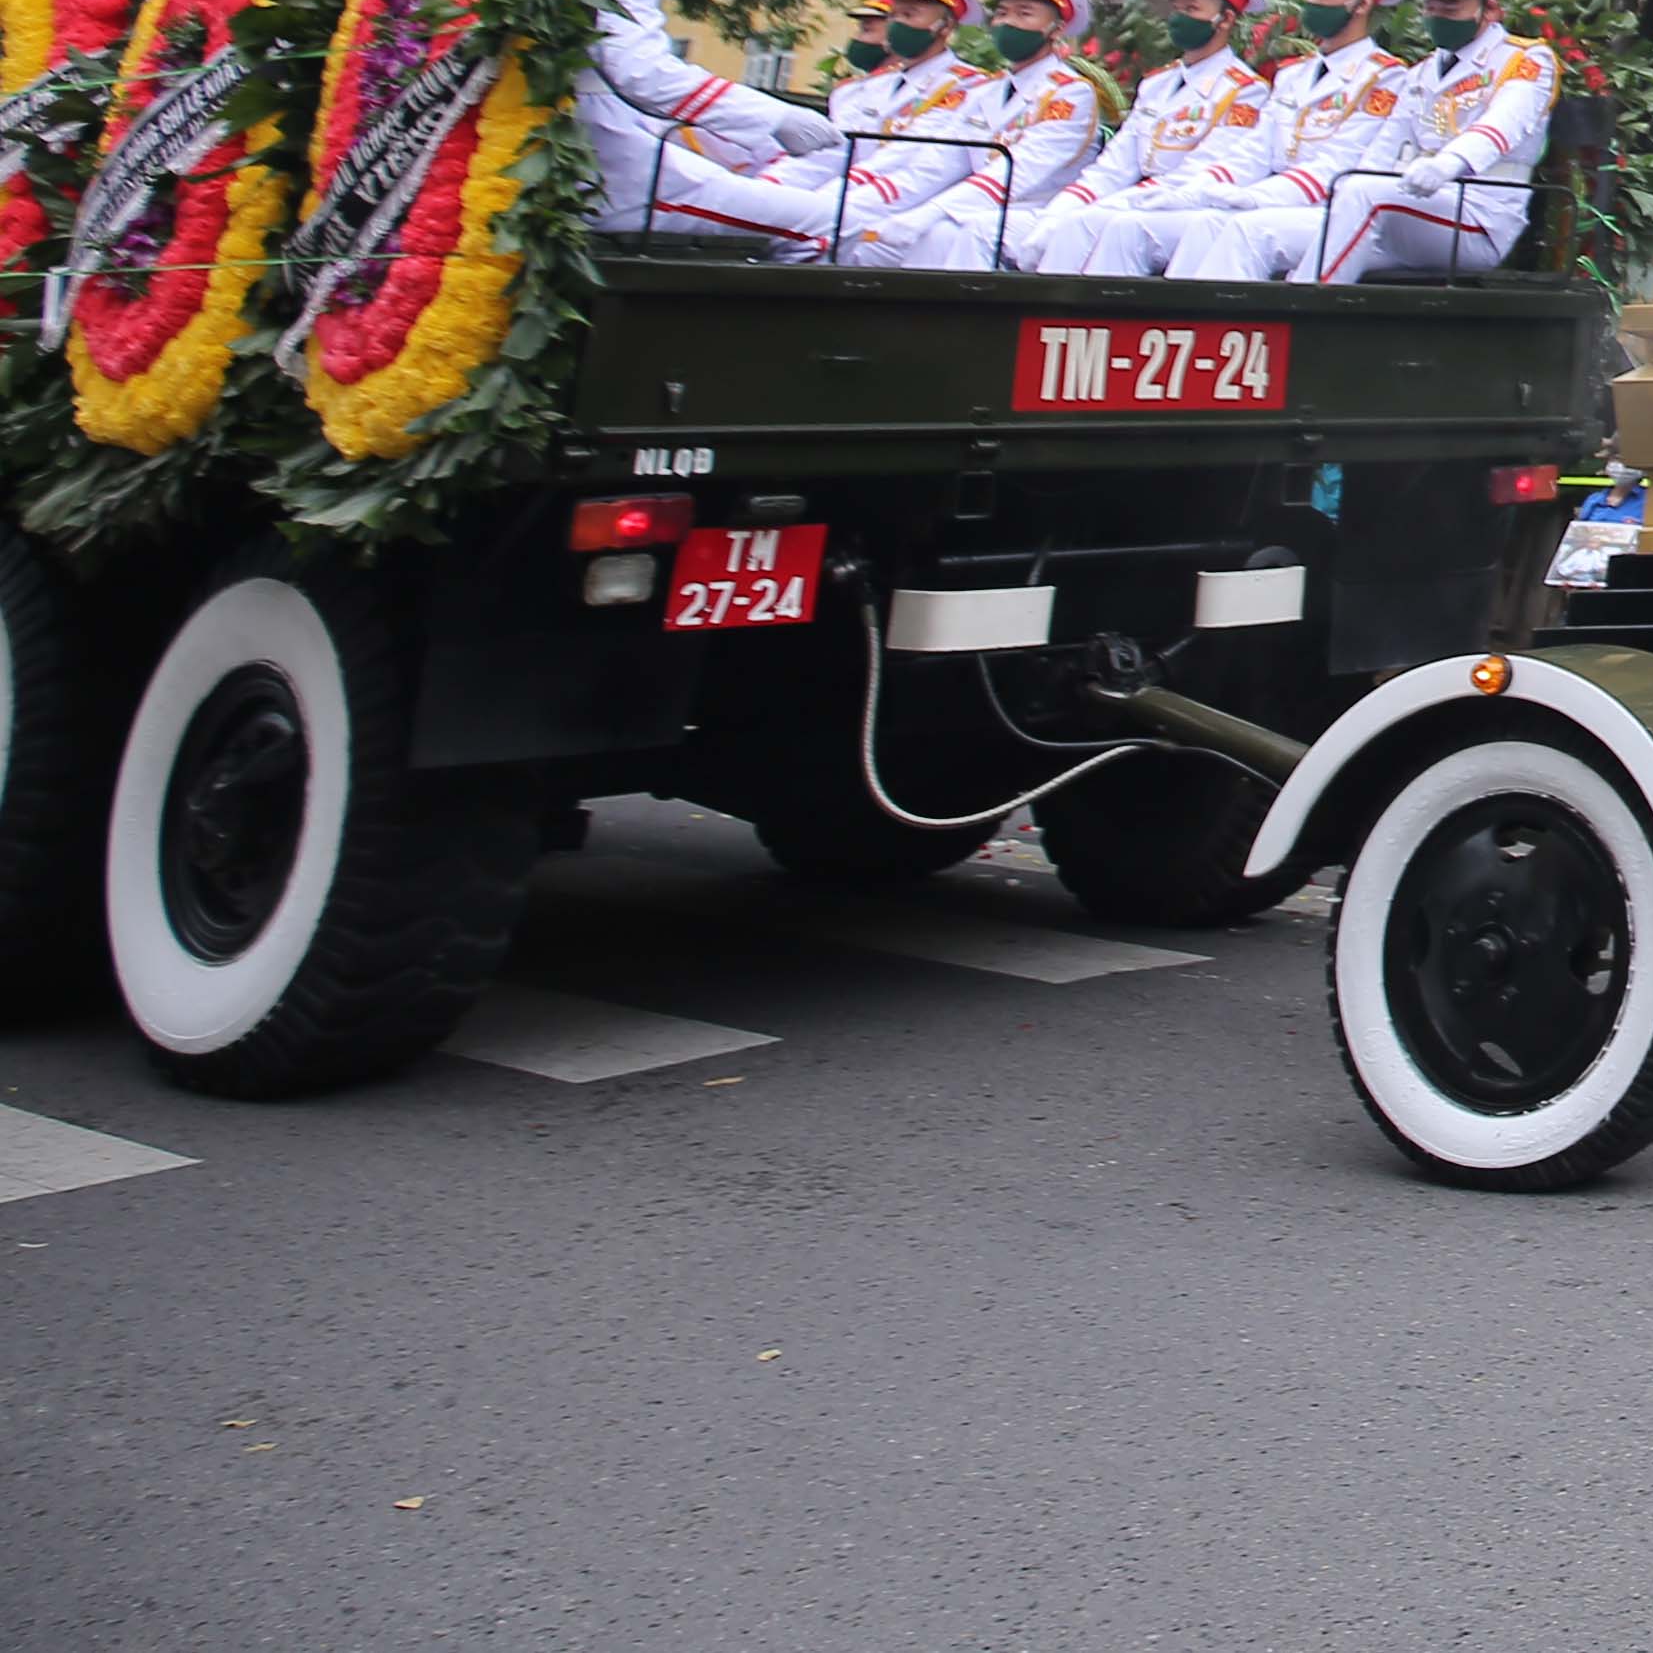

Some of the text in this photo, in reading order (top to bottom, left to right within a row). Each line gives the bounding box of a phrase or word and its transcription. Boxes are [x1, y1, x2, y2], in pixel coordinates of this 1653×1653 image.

[1040, 326, 1270, 401] TM-27-24
[726, 529, 782, 573] TM
[675, 576, 805, 626] 27-24
